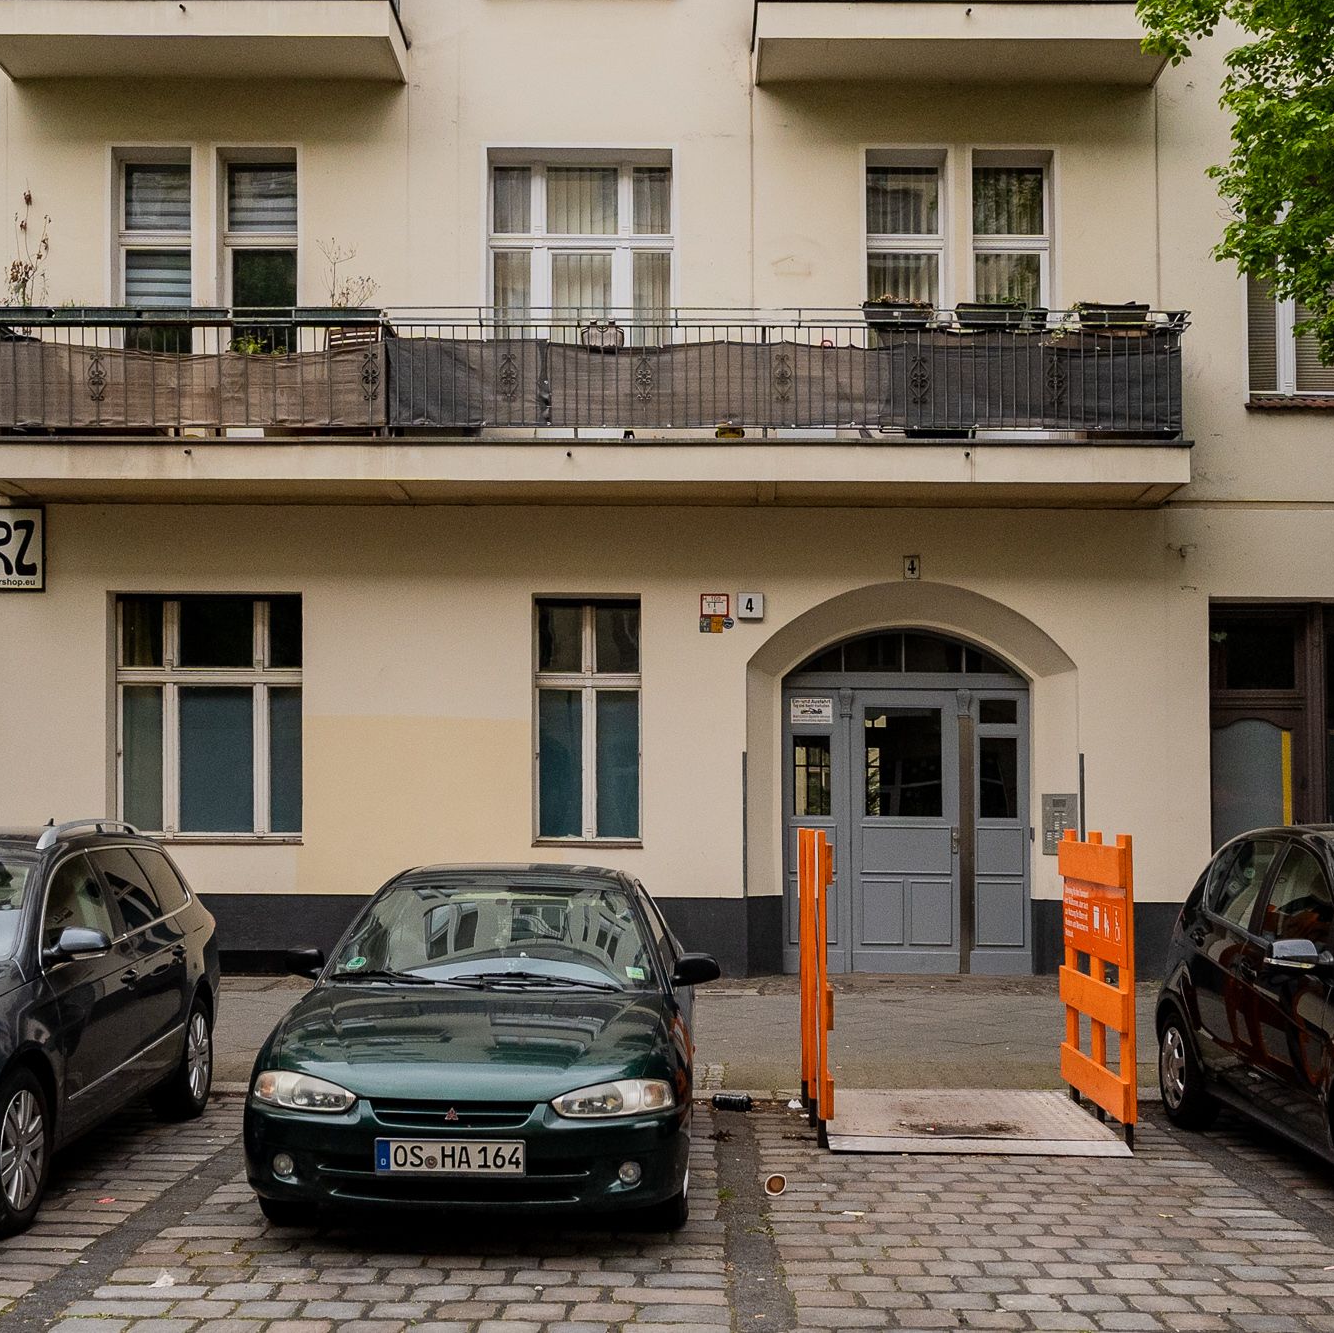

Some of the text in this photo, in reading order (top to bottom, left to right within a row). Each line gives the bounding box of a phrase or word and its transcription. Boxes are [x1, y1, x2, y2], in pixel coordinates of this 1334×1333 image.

[907, 559, 917, 575] 4
[745, 597, 754, 613] 4
[393, 1145, 424, 1168] OS
[441, 1146, 472, 1169] HA
[477, 1146, 522, 1169] 164
